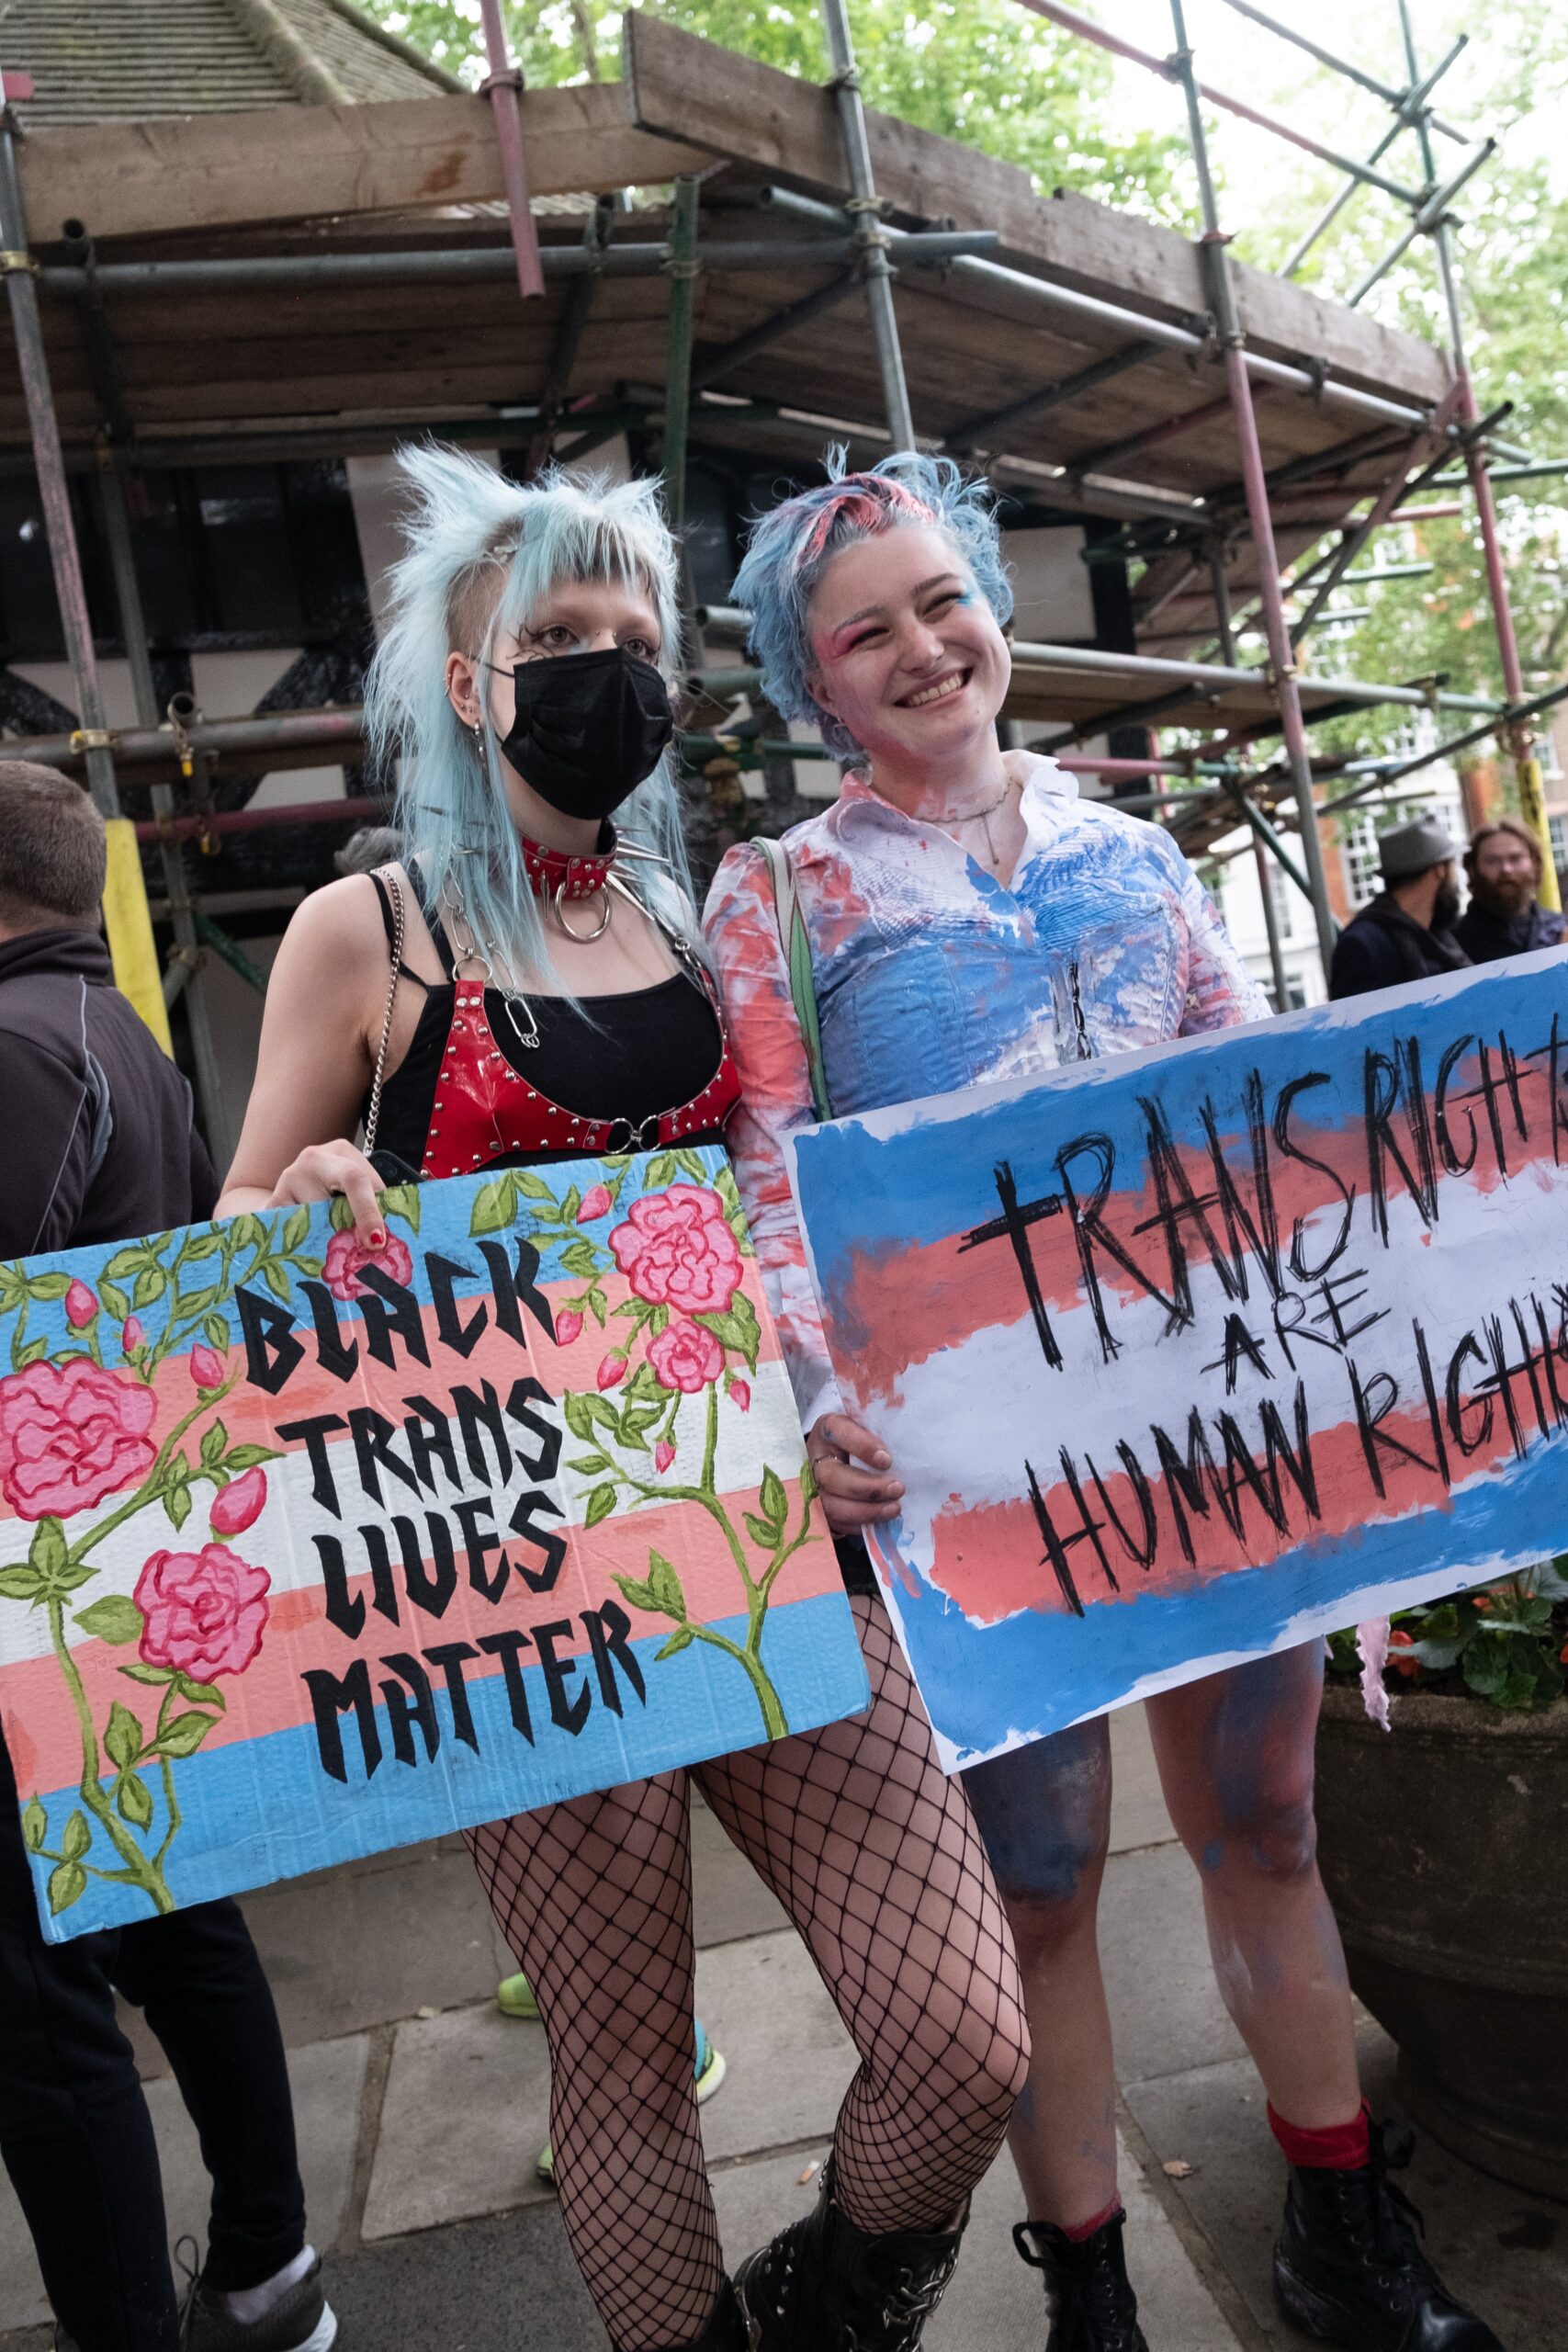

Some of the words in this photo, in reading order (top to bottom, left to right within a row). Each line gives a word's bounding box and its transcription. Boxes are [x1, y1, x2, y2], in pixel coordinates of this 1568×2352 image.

[957, 1068, 1357, 1372] TRANS
[1364, 1012, 1568, 1248] RIGHT
[233, 1236, 558, 1396] BLACK
[1200, 1269, 1391, 1396] ARE
[276, 1376, 566, 1521] TRANS
[1025, 1377, 1321, 1618] HUMAN
[1344, 1281, 1568, 1499] RIGHT
[310, 1488, 569, 1641] LIVES
[300, 1595, 648, 1784] MATTER
